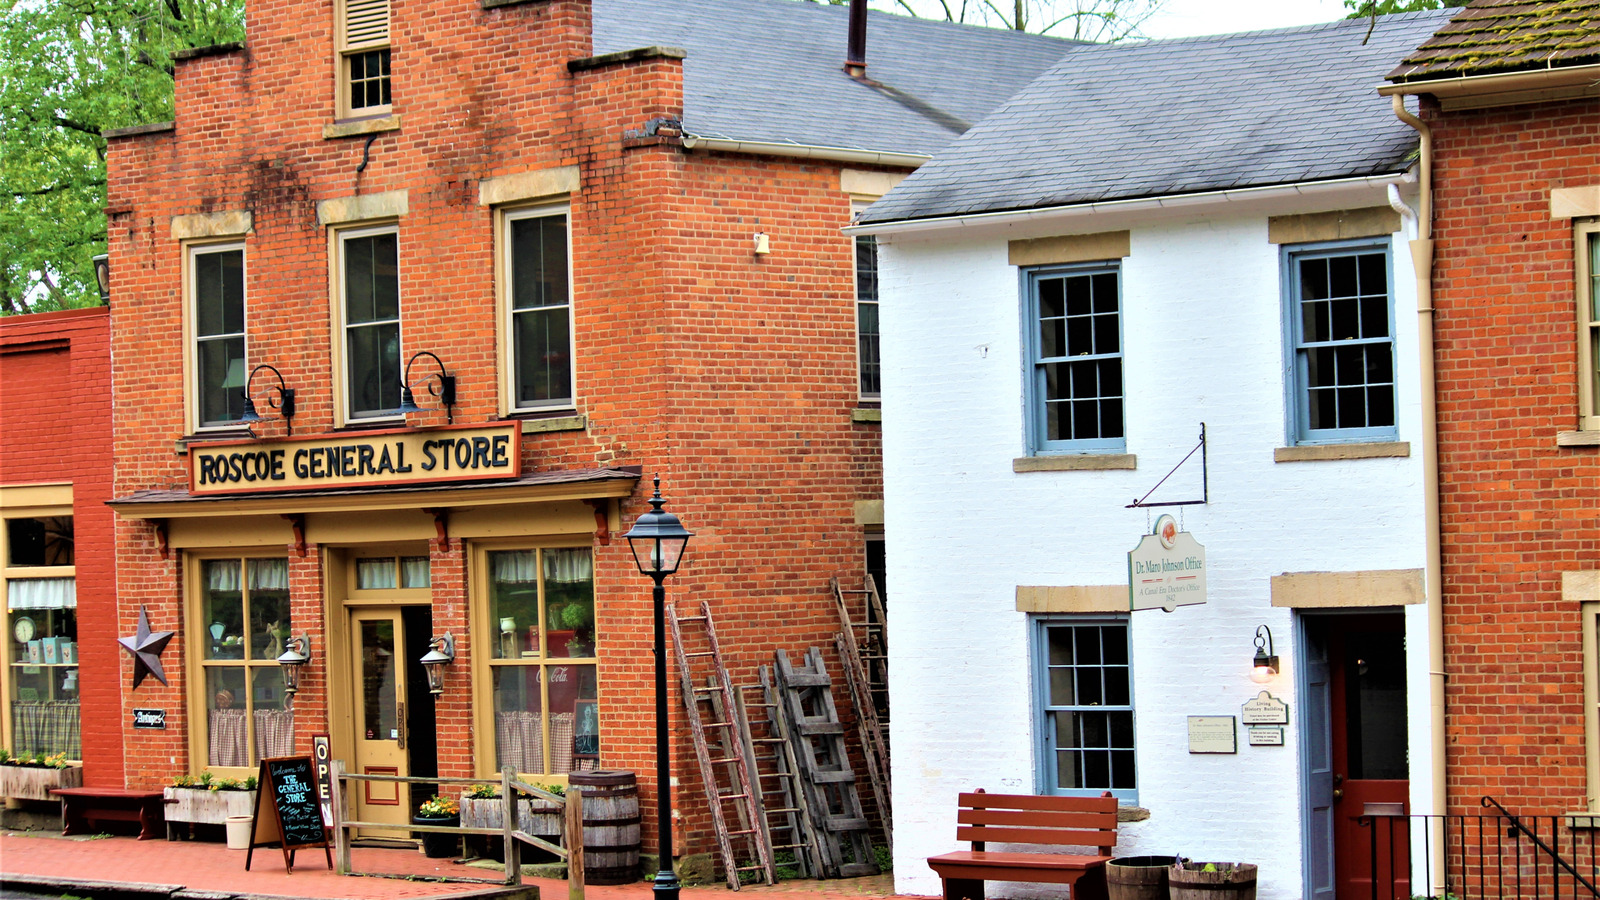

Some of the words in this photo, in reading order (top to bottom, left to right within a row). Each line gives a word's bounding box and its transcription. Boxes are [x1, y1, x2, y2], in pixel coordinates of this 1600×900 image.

[199, 449, 285, 484] ROSCOE
[293, 441, 412, 478] GENERAL
[421, 434, 510, 470] STORE
[1136, 561, 1145, 574] Dr.
[1146, 560, 1160, 573] Maro
[1161, 558, 1184, 573] Johnson
[1184, 556, 1202, 570] Office
[1139, 588, 1144, 596] A
[1144, 587, 1158, 595] Canal
[1159, 586, 1167, 594] Era
[1186, 583, 1200, 591] Office
[283, 774, 298, 784] THE
[316, 744, 334, 827] OPEN
[278, 782, 311, 793] GENERAL
[285, 792, 306, 803] STORE
